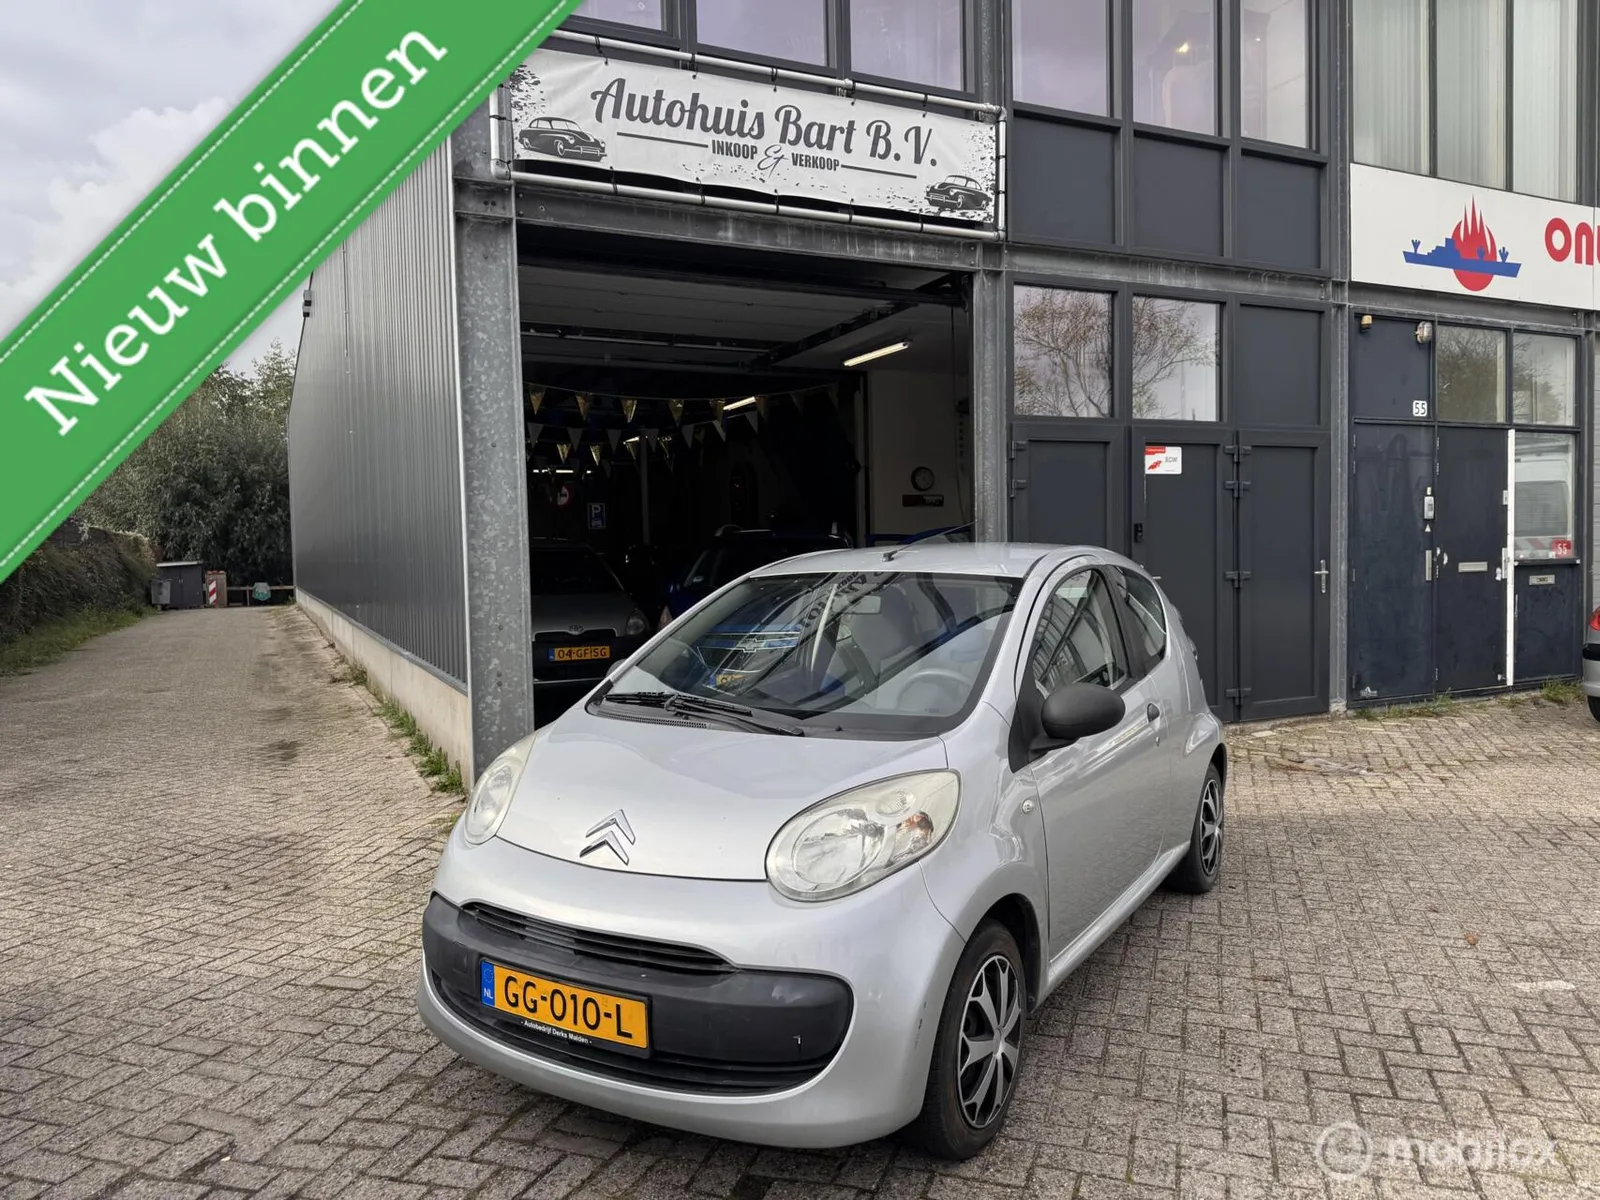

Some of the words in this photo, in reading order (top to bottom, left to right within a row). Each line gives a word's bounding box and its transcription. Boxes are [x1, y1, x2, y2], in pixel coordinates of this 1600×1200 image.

[590, 77, 765, 140] Autohuis
[774, 104, 856, 154] Bart
[866, 119, 937, 168] B.V.
[711, 139, 758, 160] INKOOP
[791, 152, 840, 171] VERKOOP
[1414, 402, 1426, 415] 55
[483, 988, 494, 999] NL
[504, 975, 633, 1039] GG-010-L
[524, 1019, 552, 1035] Autobedrijf
[552, 1028, 568, 1039] Derks
